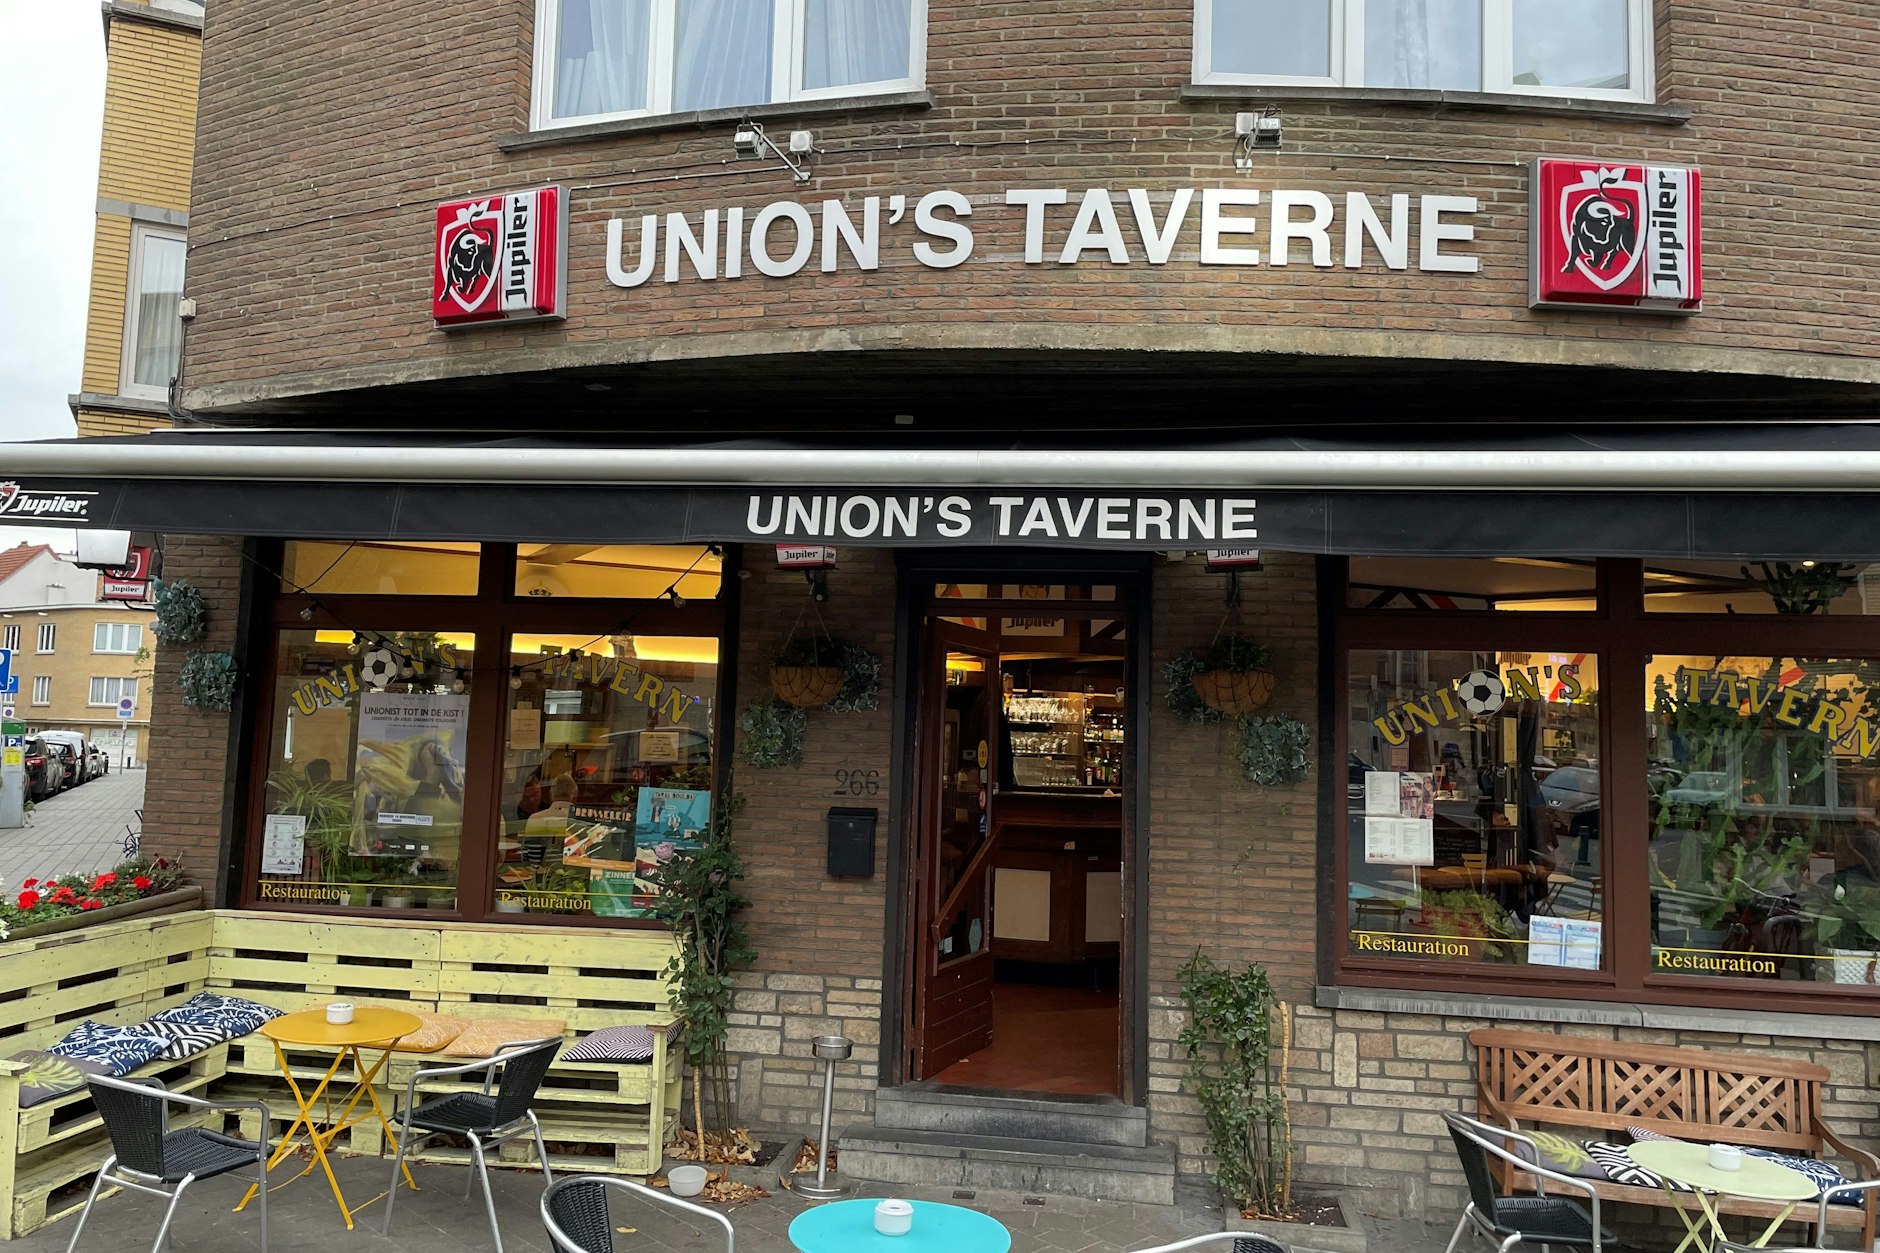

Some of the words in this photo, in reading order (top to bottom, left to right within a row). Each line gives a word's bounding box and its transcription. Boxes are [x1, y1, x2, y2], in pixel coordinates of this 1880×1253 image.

[605, 189, 974, 288] UNION'S
[1005, 188, 1479, 273] TAVERNE
[1652, 170, 1685, 295] Jupiler
[505, 196, 531, 305] Jupiler
[8, 495, 88, 516] Jupiler
[746, 494, 973, 538] UNION'S
[989, 496, 1258, 540] TAVERNE
[784, 550, 819, 560] Jupiler
[111, 585, 140, 593] Jupiler
[364, 706, 401, 715] UNIONIST
[402, 708, 419, 716] TOT
[420, 708, 429, 716] IN
[430, 709, 441, 717] DE
[443, 710, 459, 718] KIST
[1682, 668, 1880, 758] TAVERN
[8, 738, 16, 747] P
[833, 769, 880, 796] 266
[575, 807, 632, 822] BRUSSELEIR
[260, 883, 349, 900] Restauration
[500, 892, 592, 910] Restauration
[1357, 933, 1470, 957] Restauration
[1656, 949, 1777, 974] Restauration
